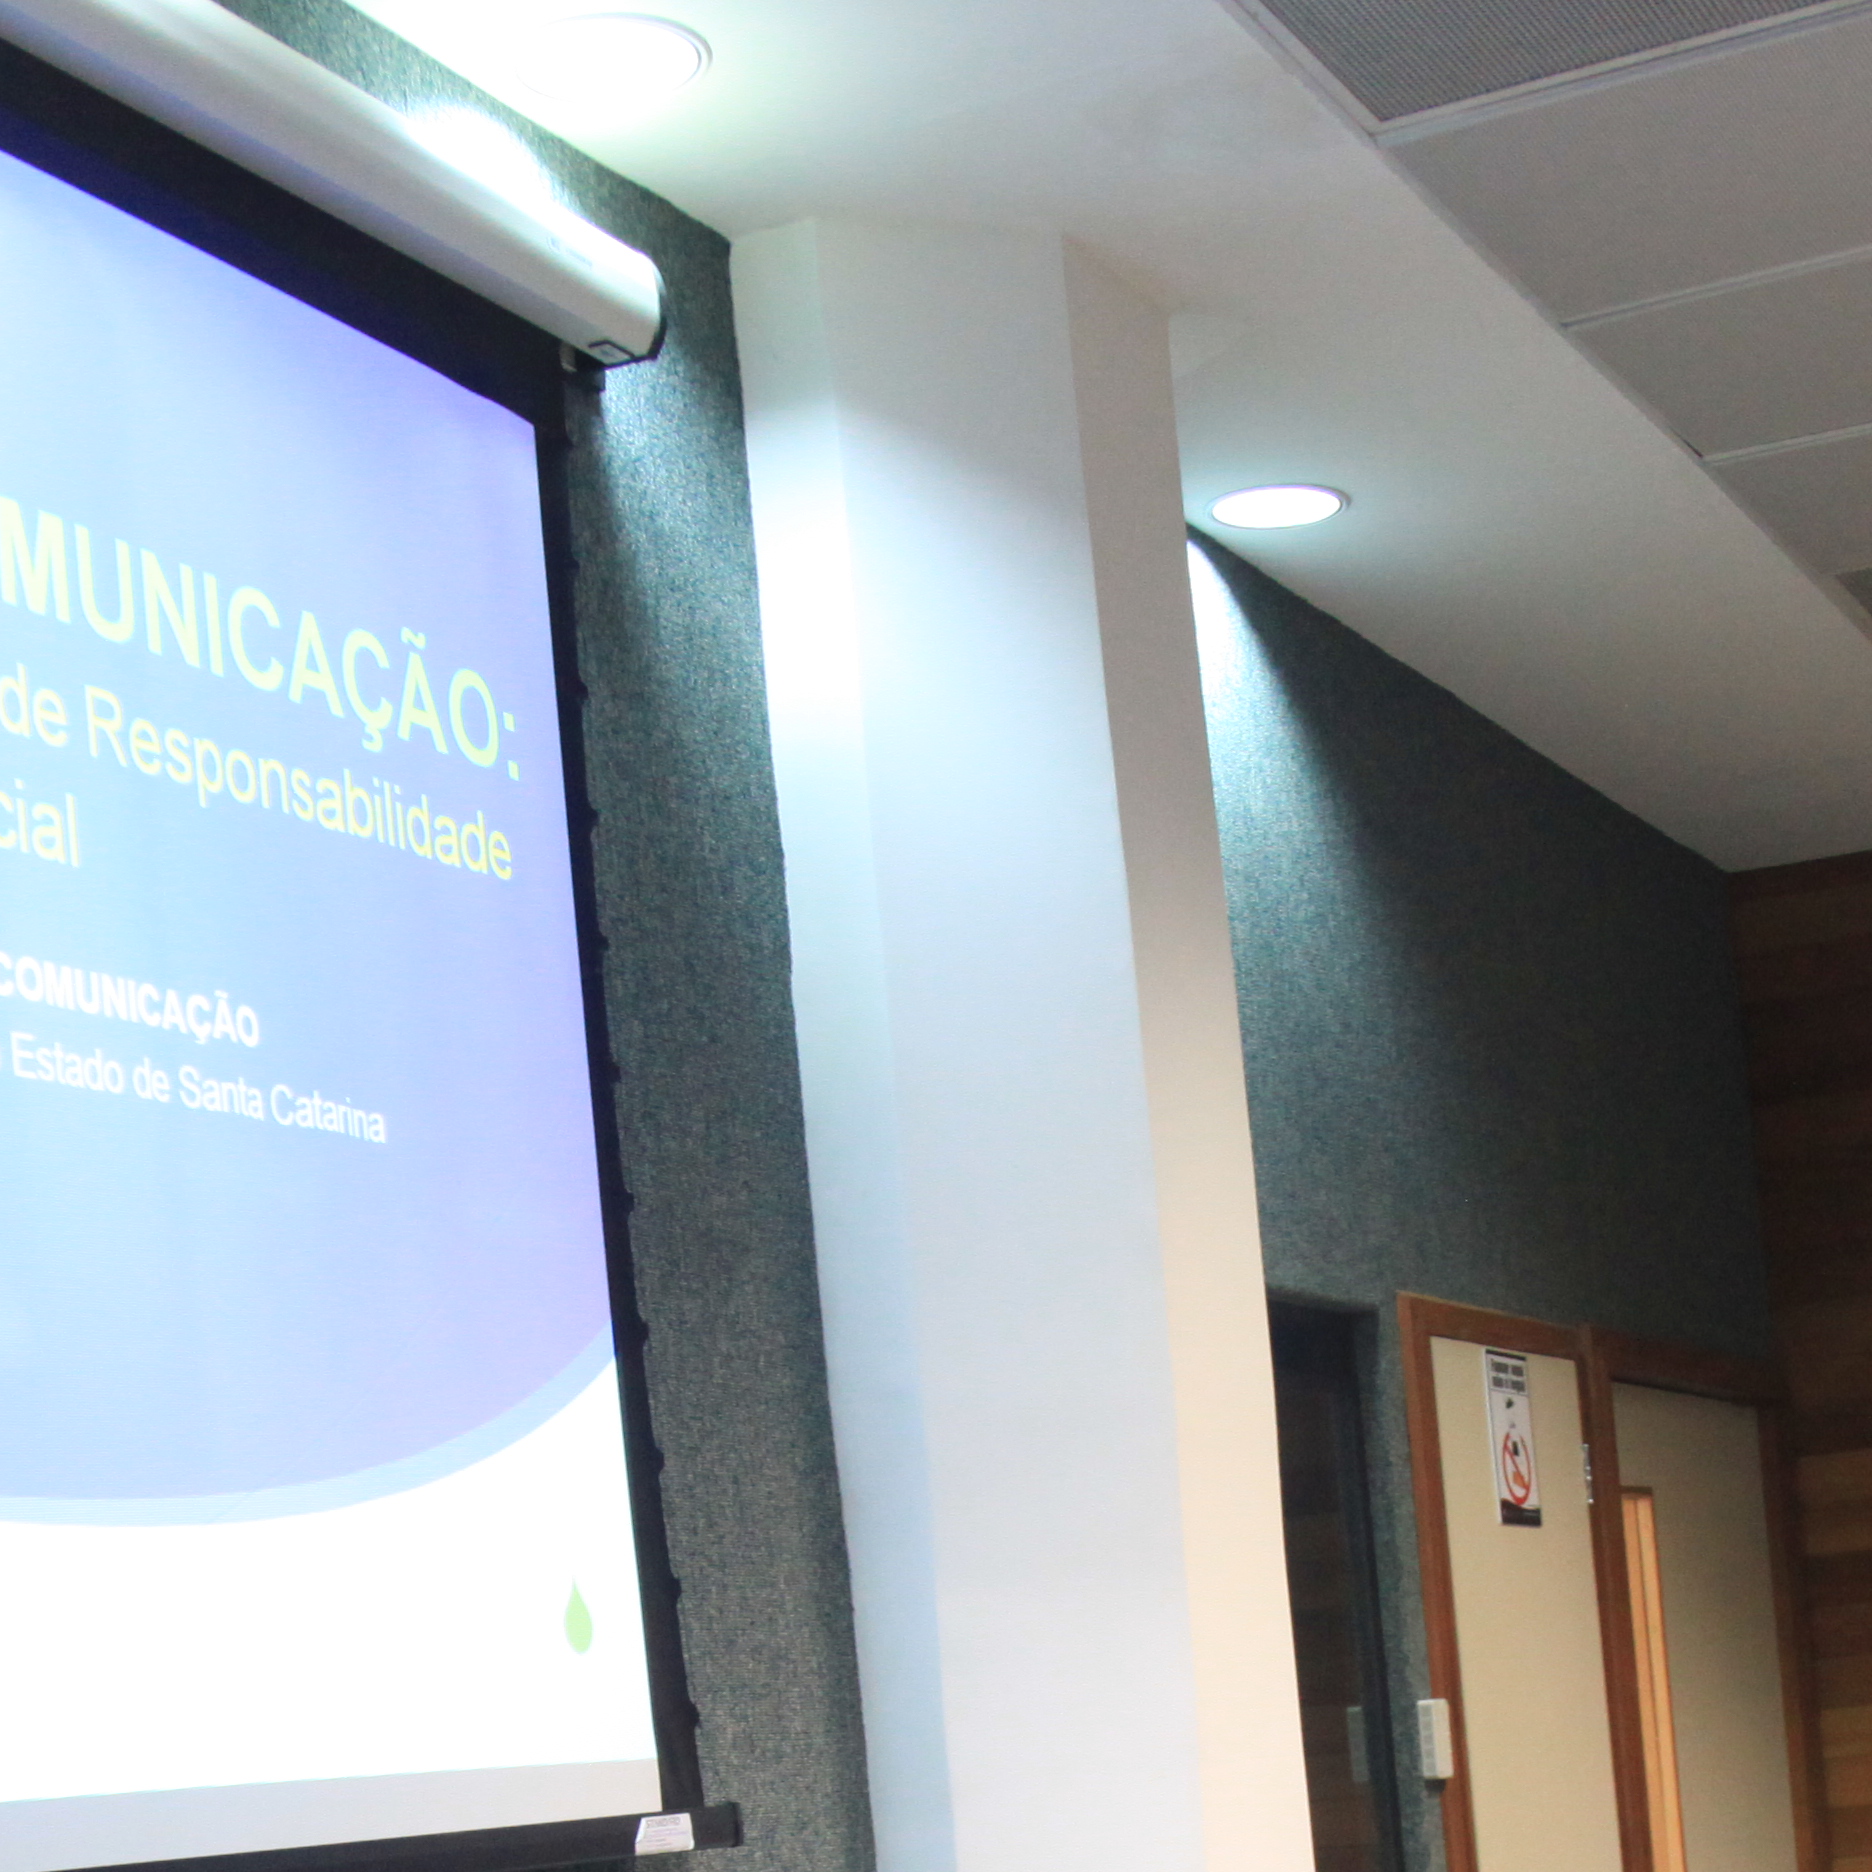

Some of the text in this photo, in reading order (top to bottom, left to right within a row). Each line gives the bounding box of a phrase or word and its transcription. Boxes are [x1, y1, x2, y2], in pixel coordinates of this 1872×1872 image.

[86, 685, 514, 881] Responsabilidade
[10, 1030, 126, 1098] Estado
[132, 1050, 172, 1102] de
[178, 1064, 266, 1119] Santa
[270, 1079, 387, 1142] Catarina
